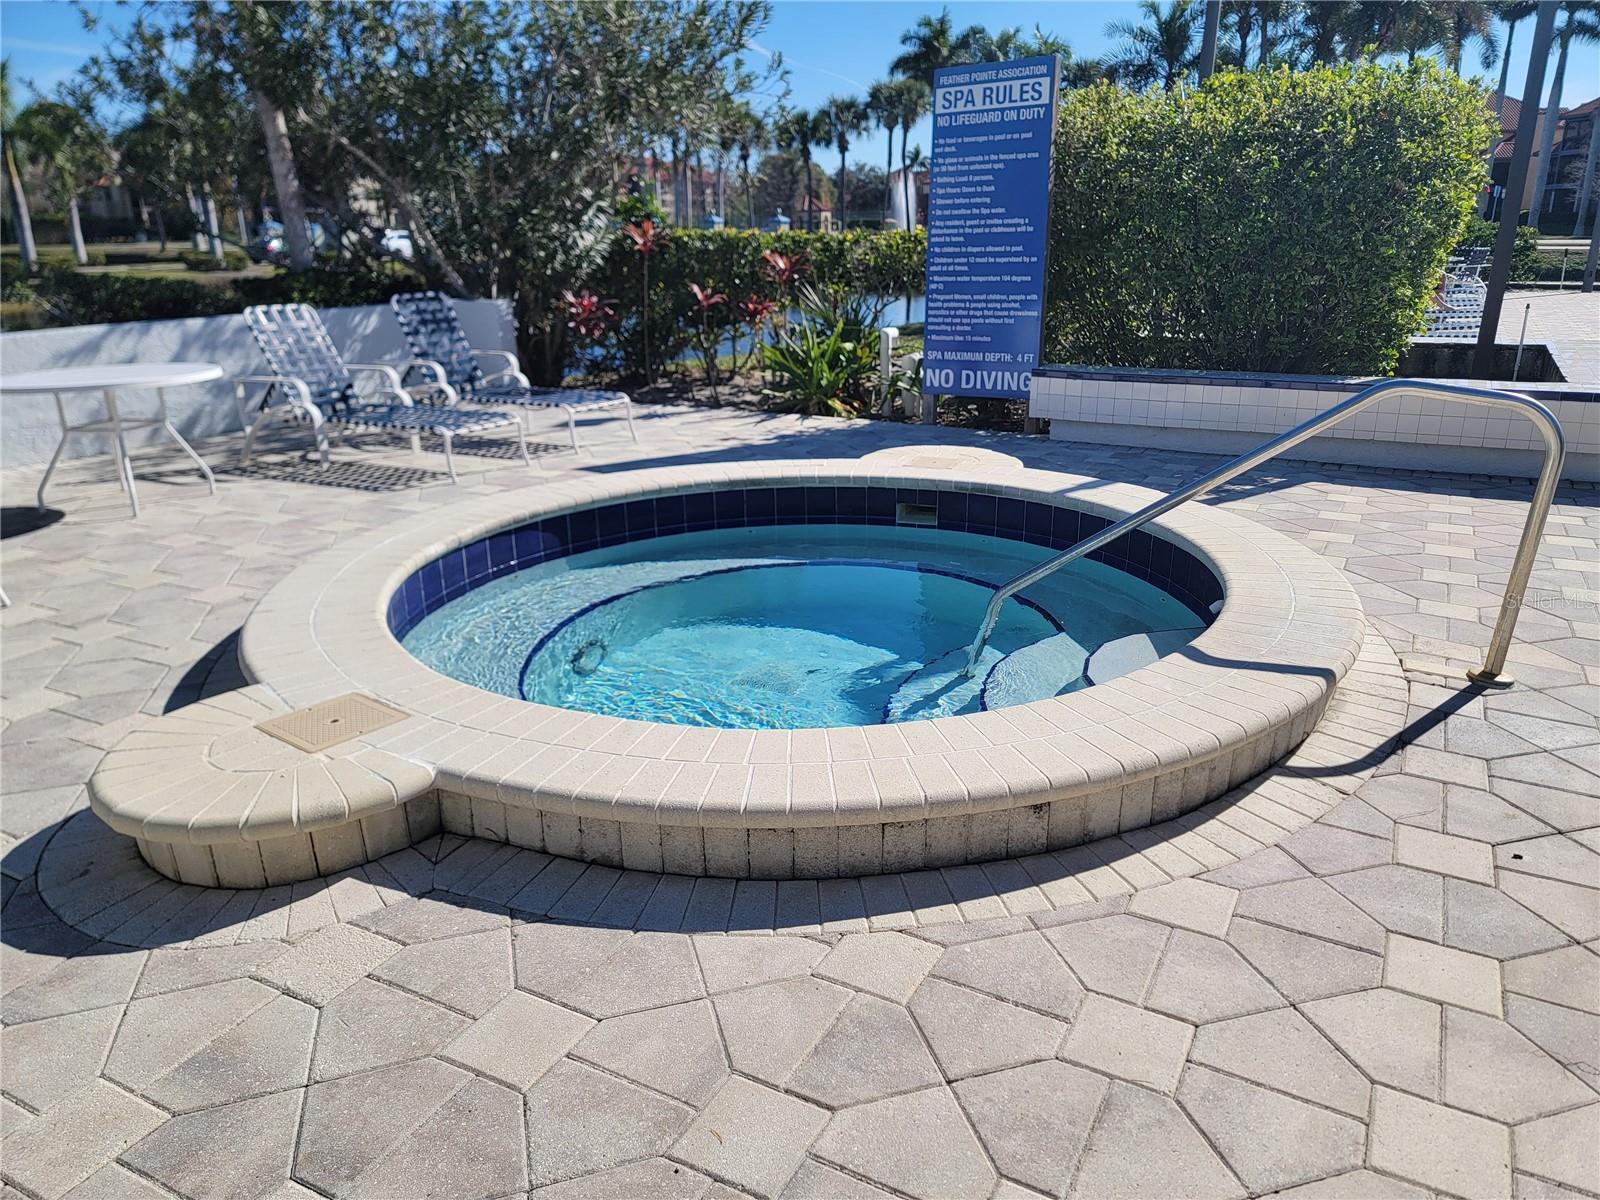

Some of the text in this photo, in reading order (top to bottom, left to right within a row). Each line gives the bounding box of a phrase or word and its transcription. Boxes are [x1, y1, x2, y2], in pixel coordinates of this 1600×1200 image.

[940, 65, 1047, 85] FEATHER POINTE ASSOCIATION
[942, 82, 1042, 109] SPA RULES
[937, 107, 1045, 128] NO LIFEGUARD ON DUTY
[928, 351, 942, 360] SPA
[944, 352, 983, 361] MAXIMUM
[985, 353, 1013, 362] DEPTH:
[1024, 354, 1034, 363] FT
[926, 369, 1032, 391] NO DIVING
